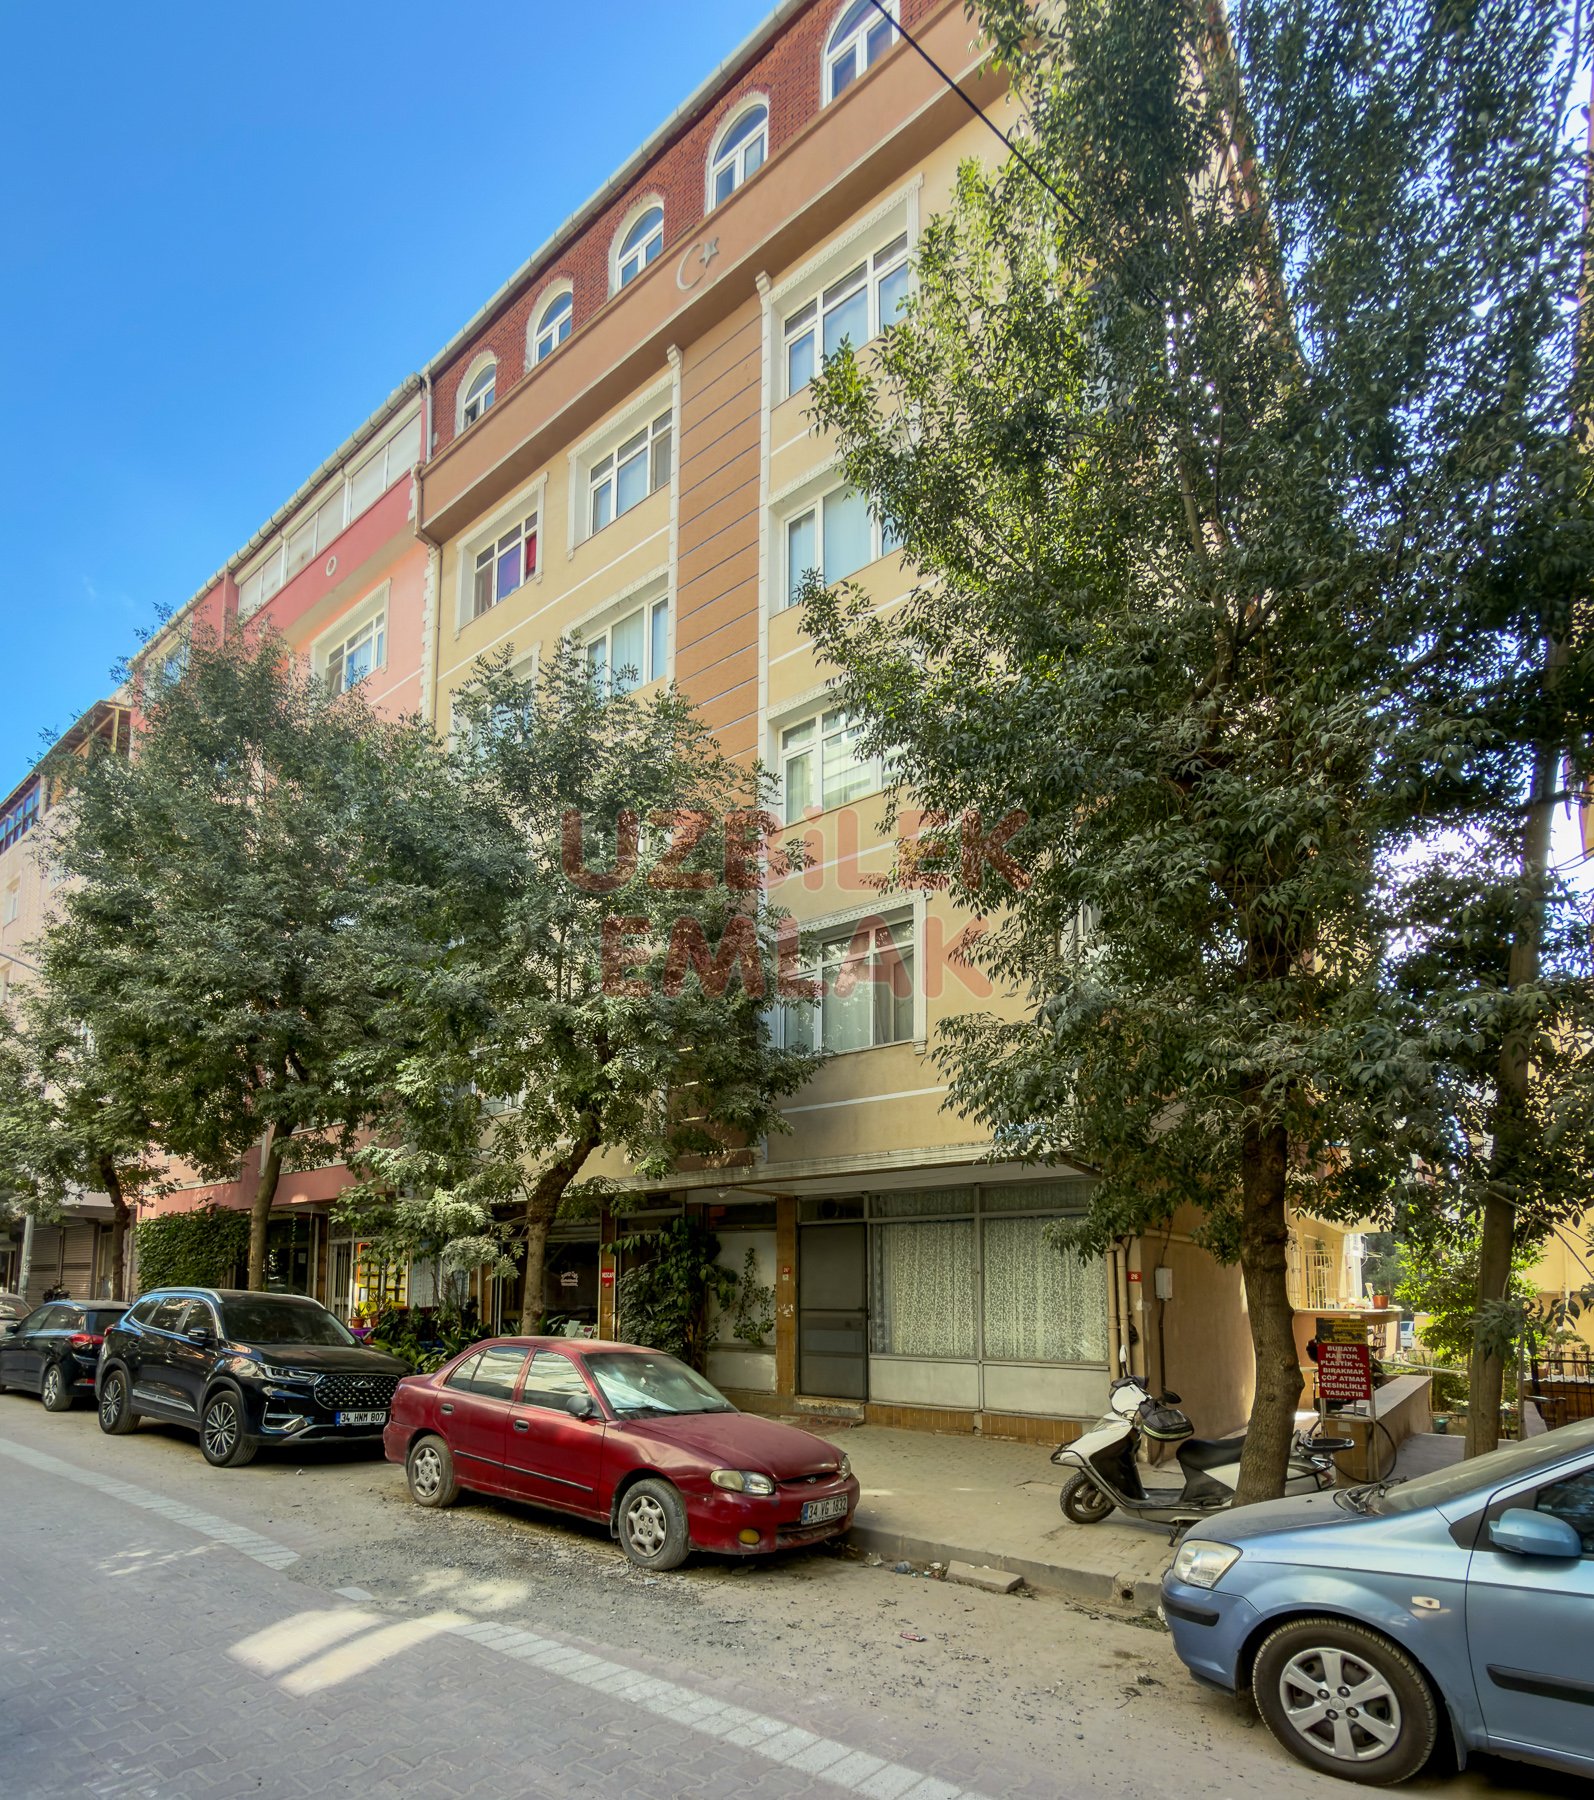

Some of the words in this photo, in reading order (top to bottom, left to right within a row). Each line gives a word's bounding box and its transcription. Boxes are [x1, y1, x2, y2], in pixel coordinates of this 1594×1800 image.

[1322, 1367, 1364, 1375] BIRAKMAK
[1339, 1375, 1366, 1383] ATMAK
[1325, 1389, 1364, 1397] YASAKTIR
[341, 1413, 350, 1422] 34
[354, 1413, 368, 1422] HNM
[370, 1412, 384, 1421] 807
[809, 1504, 817, 1518] 34
